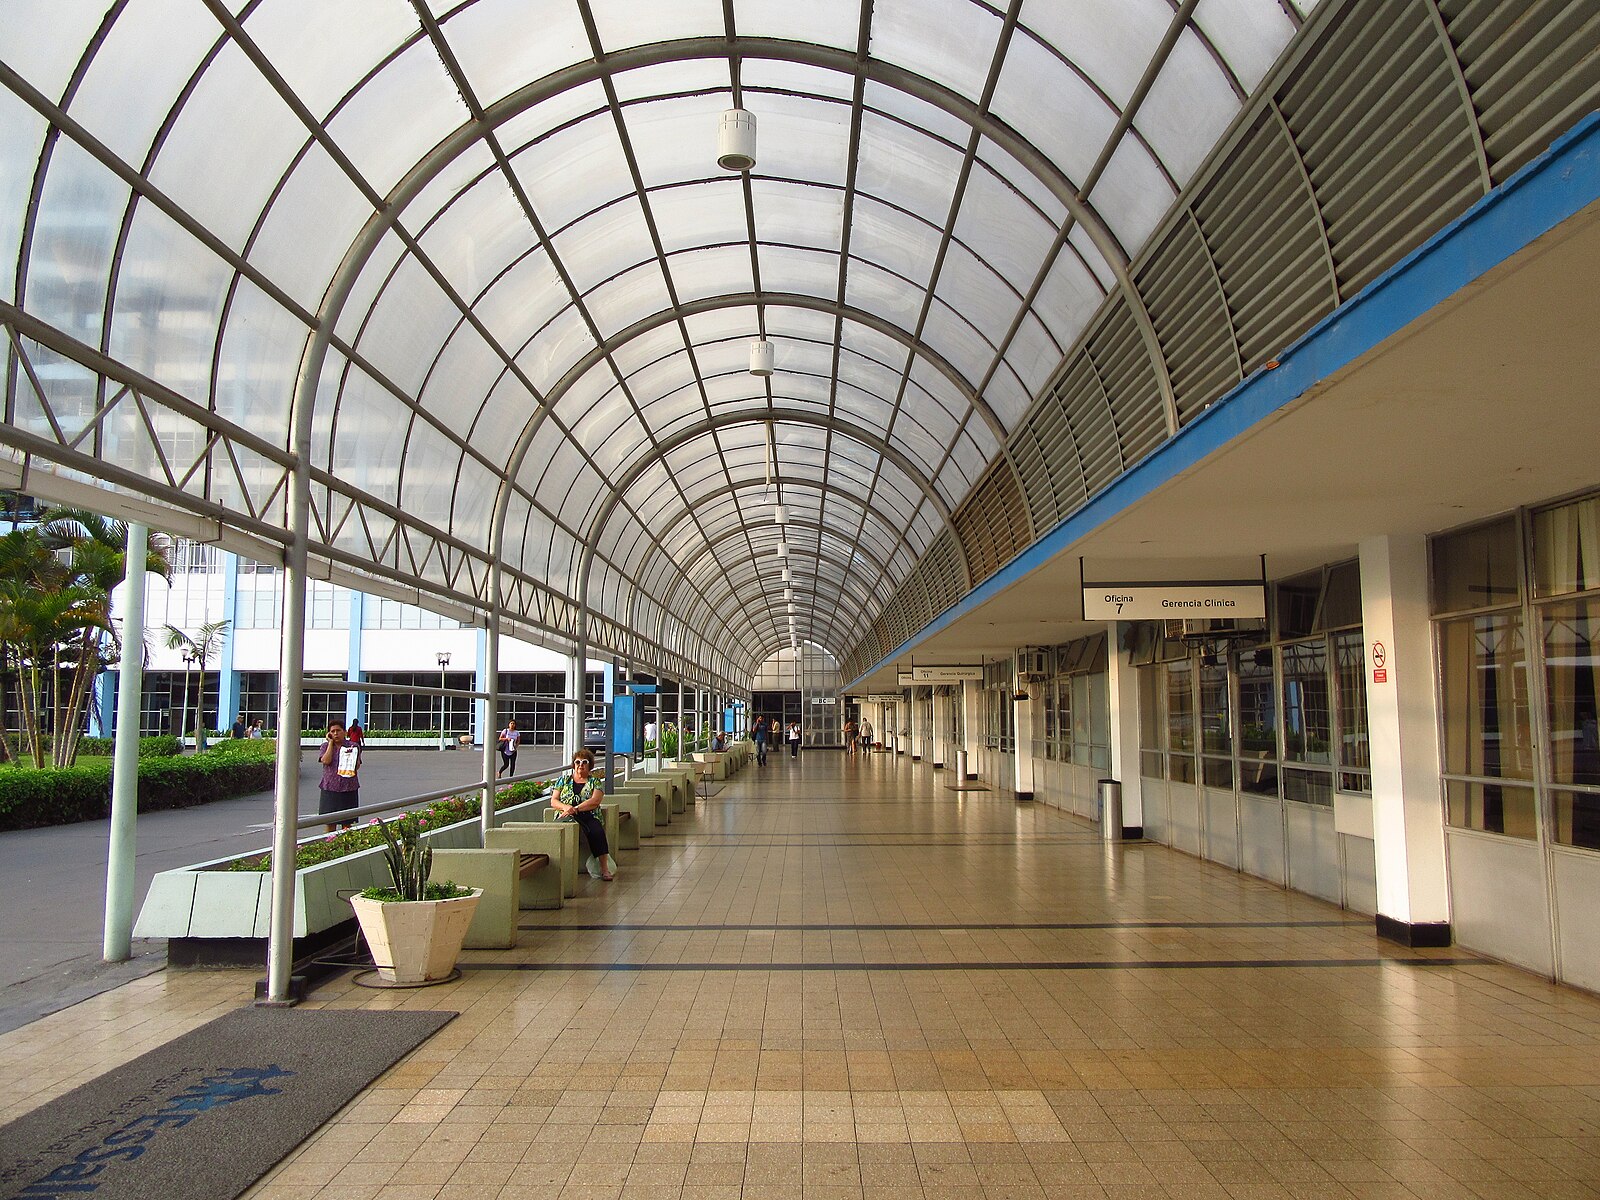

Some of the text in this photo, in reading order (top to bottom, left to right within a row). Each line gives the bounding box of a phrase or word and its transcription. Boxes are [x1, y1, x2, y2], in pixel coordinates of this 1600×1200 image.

[1104, 594, 1134, 603] Oficina
[1161, 599, 1202, 608] Gerencia
[1115, 603, 1124, 614] 7
[10, 1113, 198, 1200] EsSal
